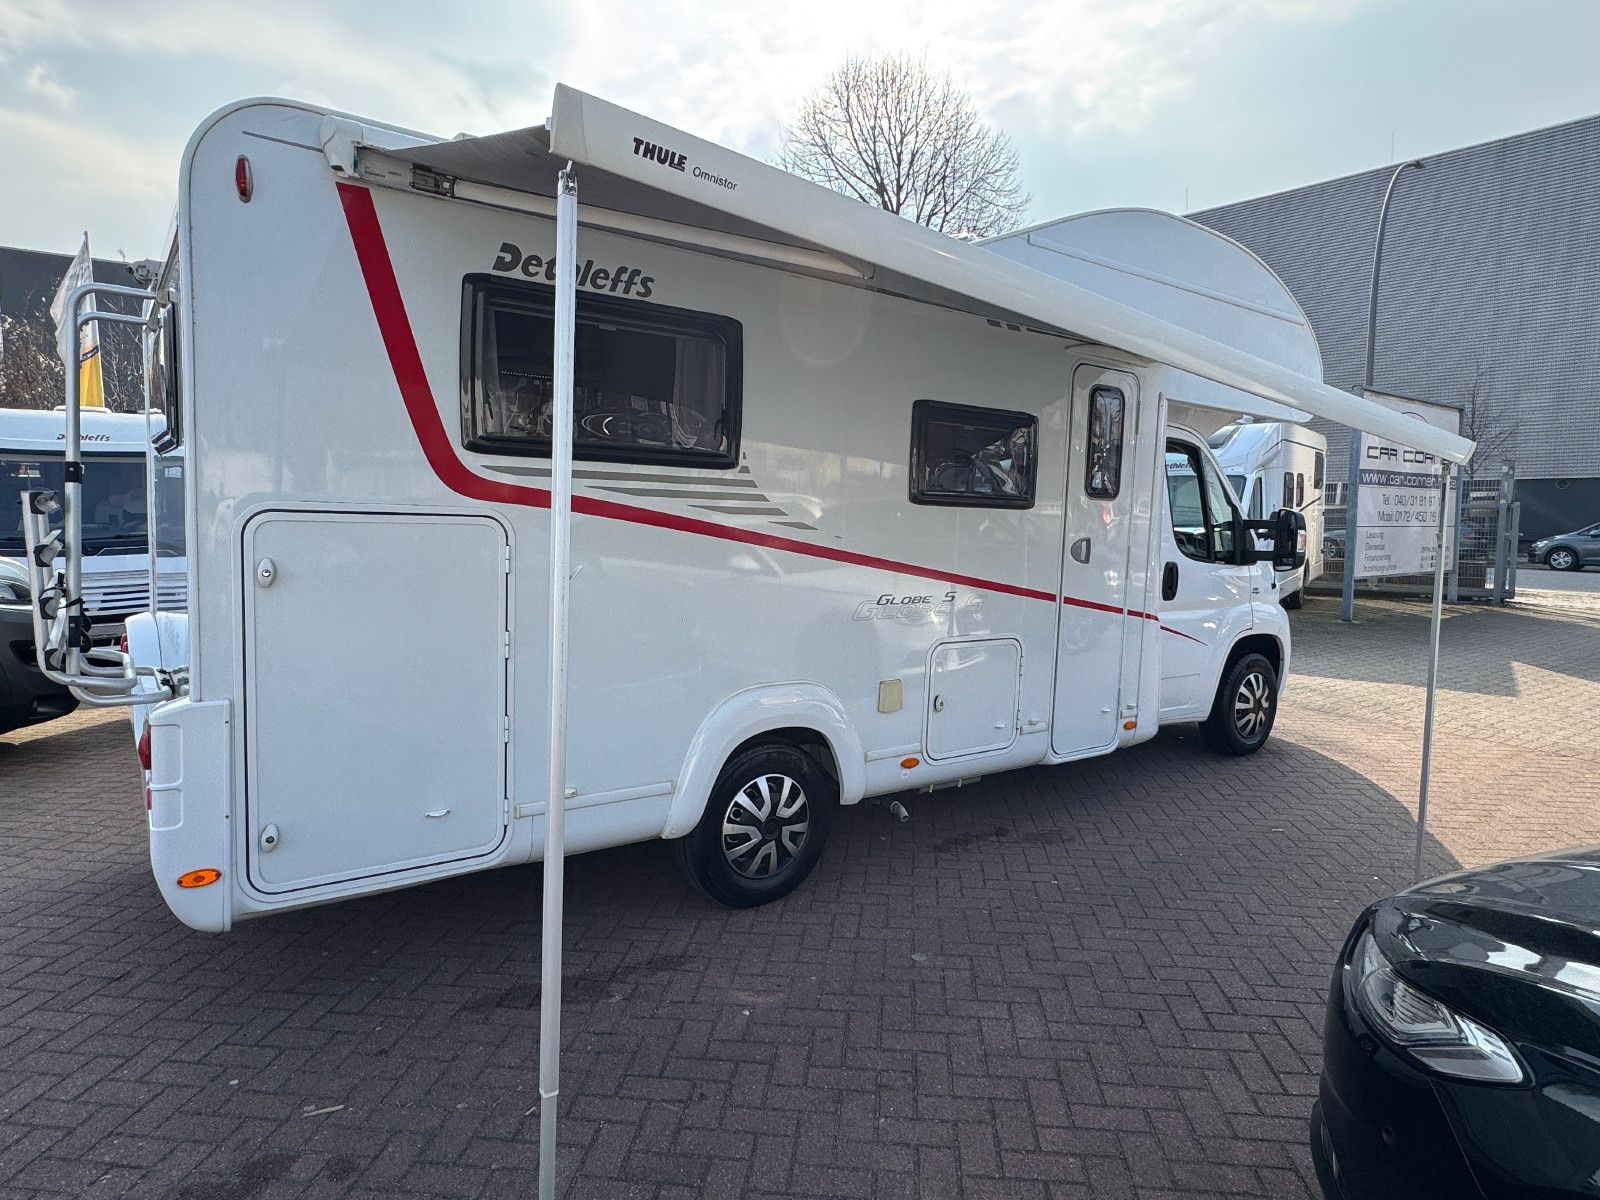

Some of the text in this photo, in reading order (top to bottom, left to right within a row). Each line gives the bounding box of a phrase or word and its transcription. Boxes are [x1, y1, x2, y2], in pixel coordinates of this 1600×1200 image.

[633, 136, 738, 191] THULE Omnistor
[1367, 446, 1397, 461] CAR
[877, 591, 957, 606] GLOBE S
